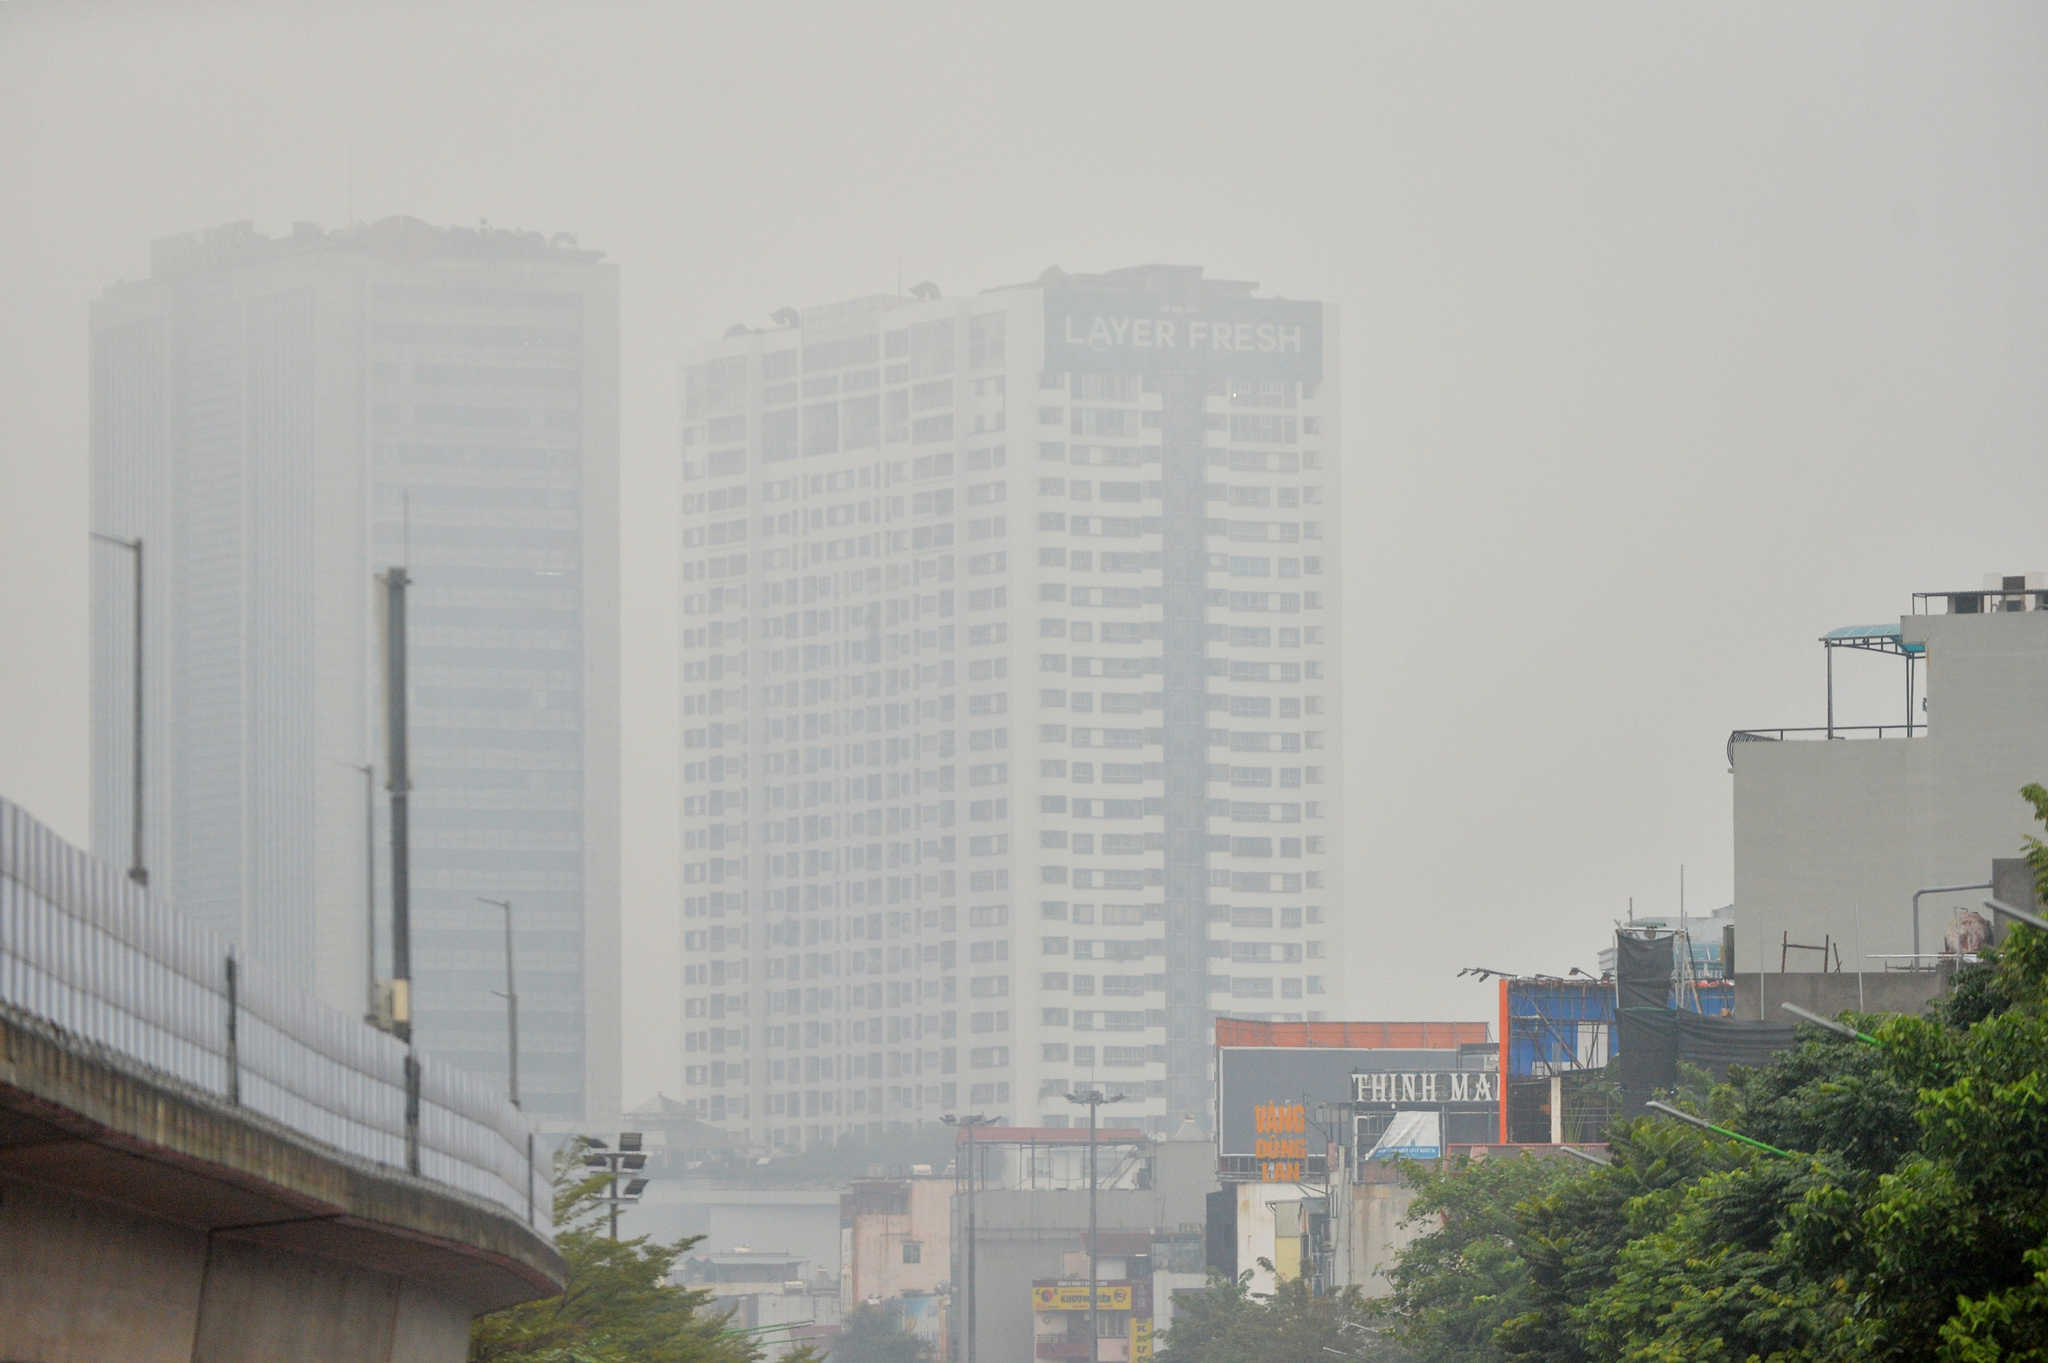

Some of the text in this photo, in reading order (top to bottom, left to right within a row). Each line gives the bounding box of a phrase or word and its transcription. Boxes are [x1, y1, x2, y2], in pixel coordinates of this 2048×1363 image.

[1065, 315, 1301, 354] LAYER FRESH
[1255, 1100, 1305, 1133] VÀNG
[1262, 1162, 1300, 1182] LAN
